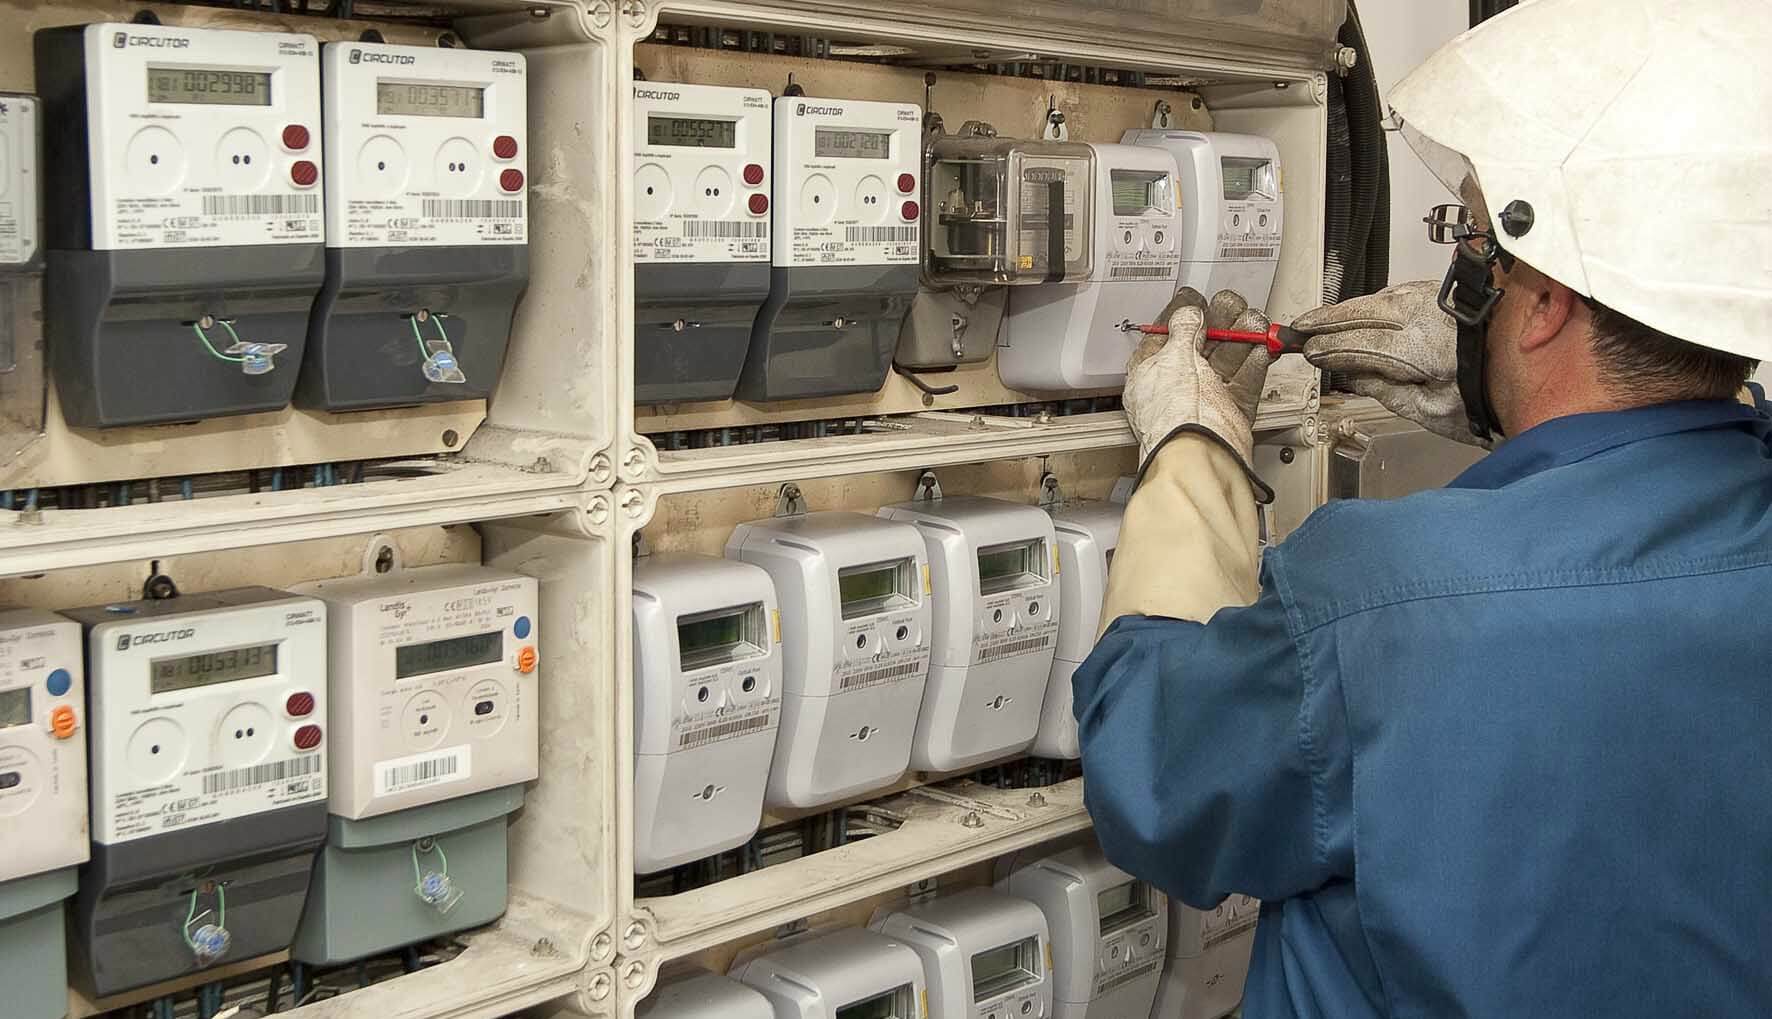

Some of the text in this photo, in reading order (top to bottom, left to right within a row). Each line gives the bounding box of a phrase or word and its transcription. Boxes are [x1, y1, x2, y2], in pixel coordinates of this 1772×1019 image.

[129, 36, 190, 48] CIRCUTOR
[362, 53, 415, 65] CIRCUTOR
[637, 90, 680, 101] CIRCUTOR
[806, 105, 844, 116] CIRCUTOR
[132, 629, 195, 646] CIRCUTOR
